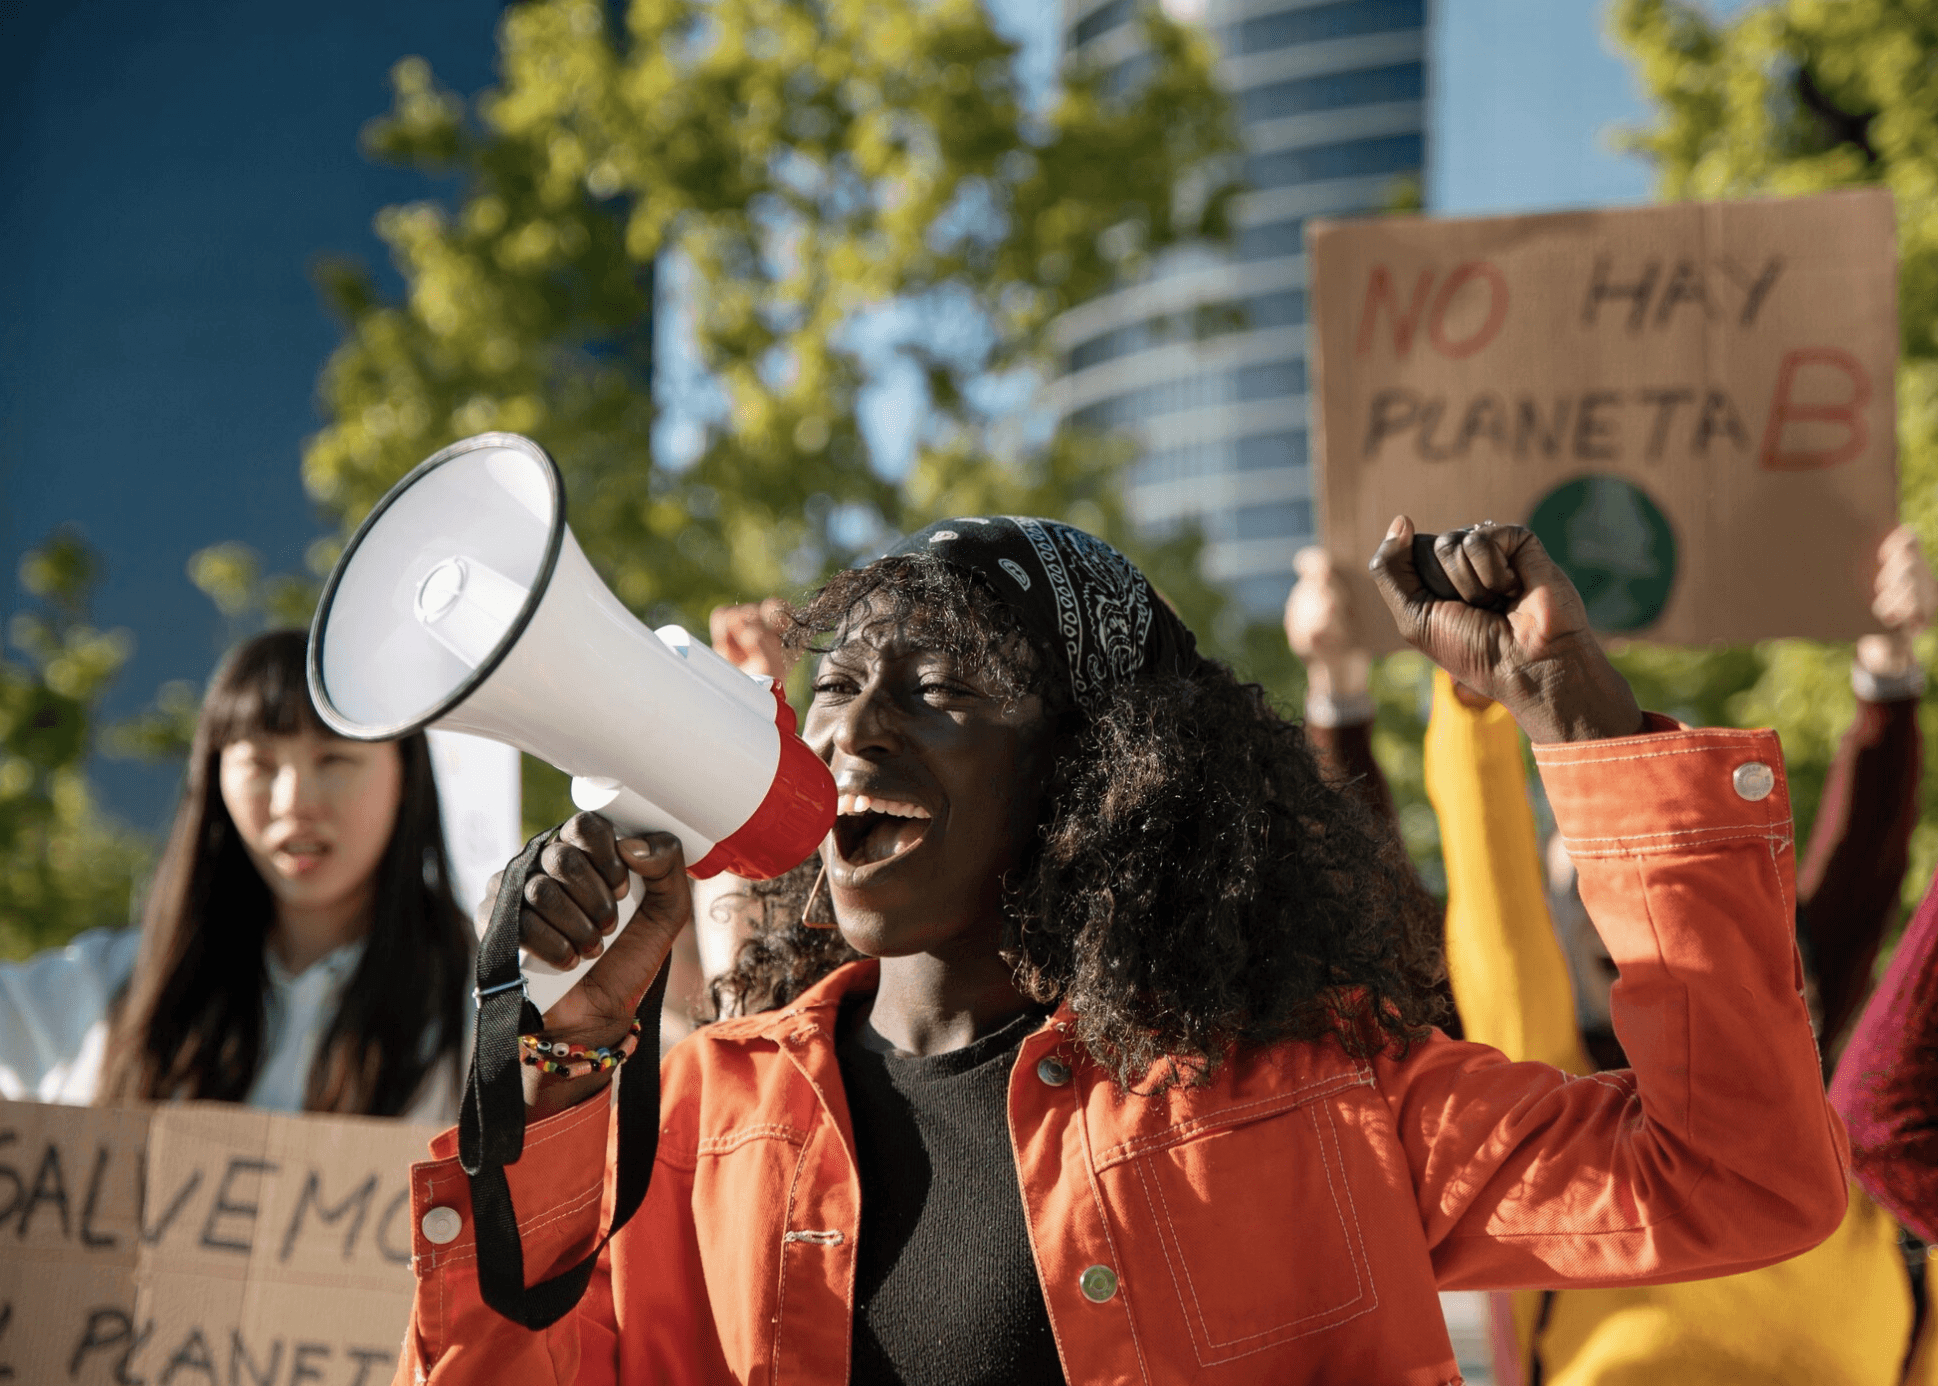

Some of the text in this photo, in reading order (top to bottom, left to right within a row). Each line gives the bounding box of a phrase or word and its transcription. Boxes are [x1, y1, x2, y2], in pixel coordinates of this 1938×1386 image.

[1353, 254, 1783, 360] NO HAY
[1362, 346, 1873, 473] PLANETA B
